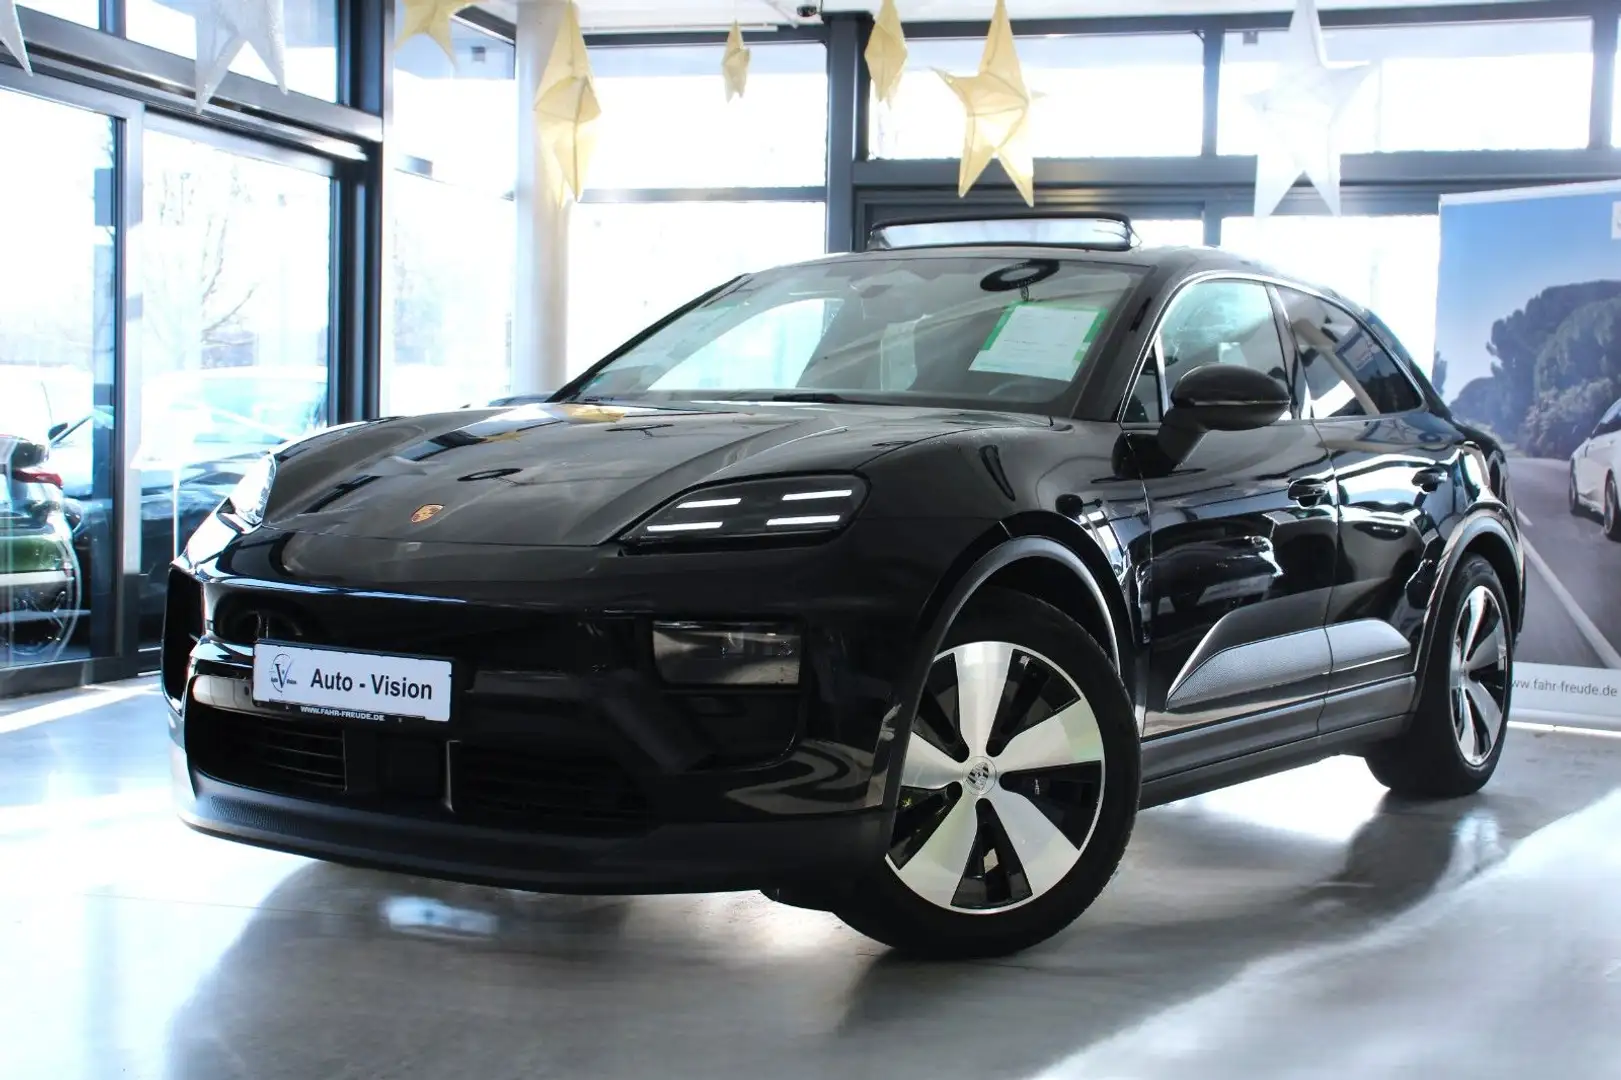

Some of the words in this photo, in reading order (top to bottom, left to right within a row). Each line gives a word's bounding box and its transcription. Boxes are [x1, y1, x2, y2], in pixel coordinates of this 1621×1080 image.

[310, 668, 353, 692] Auto
[371, 673, 432, 700] Vision
[1511, 678, 1618, 697] ww.fahr-freude.de
[300, 705, 386, 721] WWW.FAHR-FREUDE.DE
